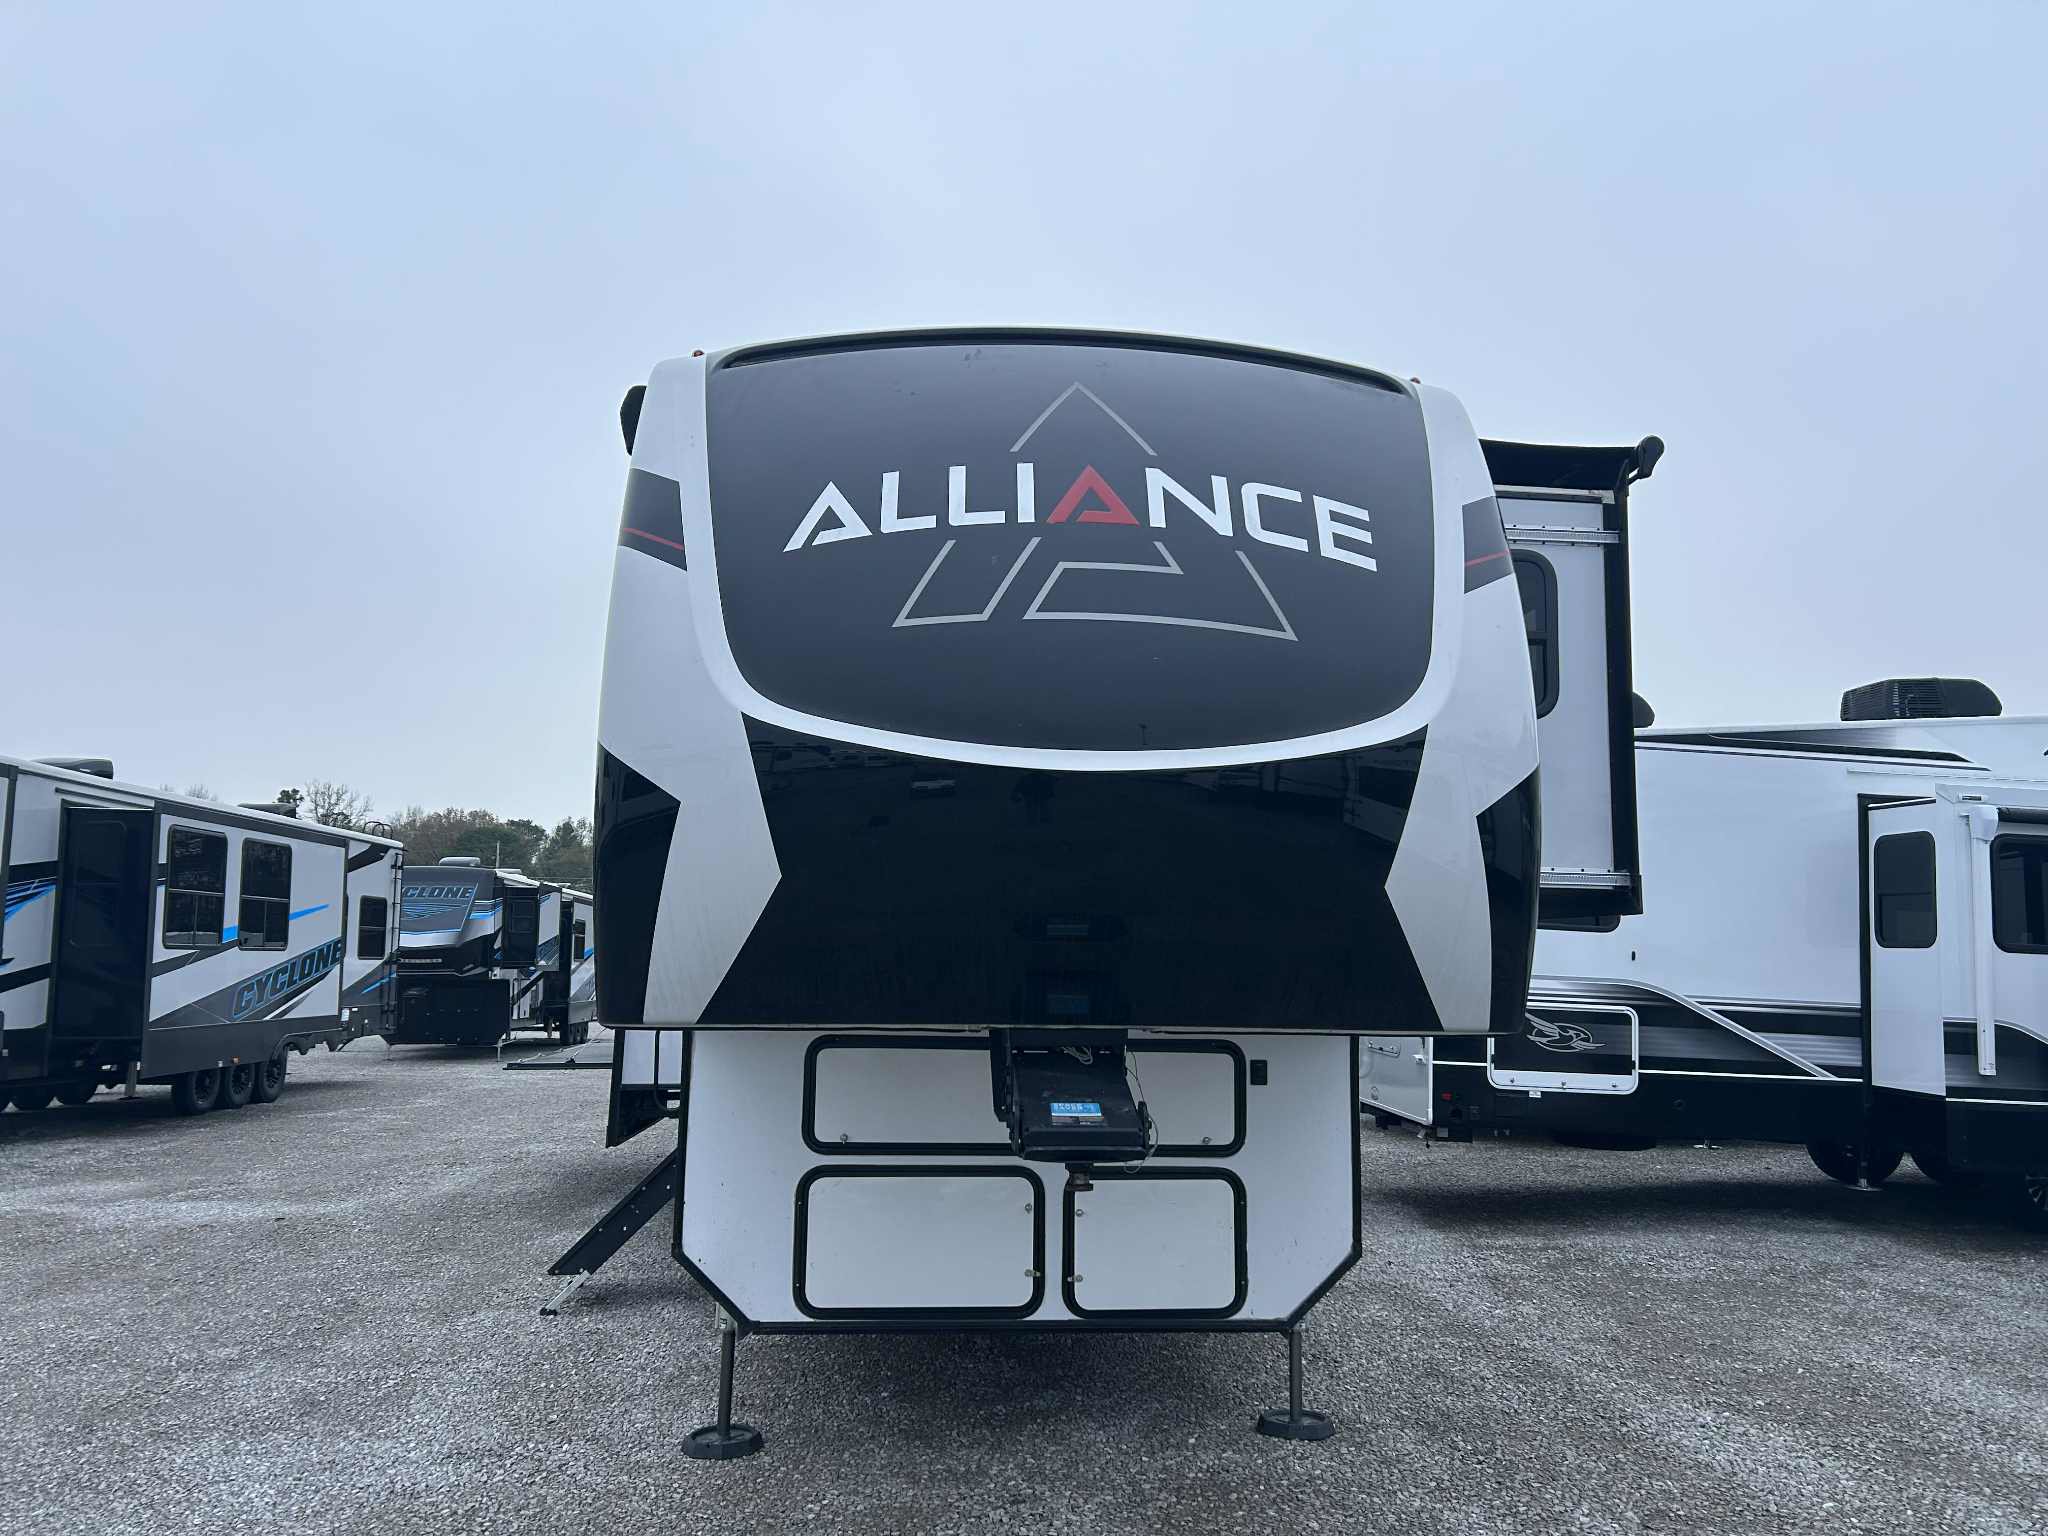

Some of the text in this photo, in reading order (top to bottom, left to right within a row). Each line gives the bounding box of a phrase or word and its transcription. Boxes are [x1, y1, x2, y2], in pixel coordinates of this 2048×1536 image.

[783, 463, 1378, 572] ALLIANCE
[400, 886, 474, 898] CLONE
[233, 939, 341, 1018] CYCLONE
